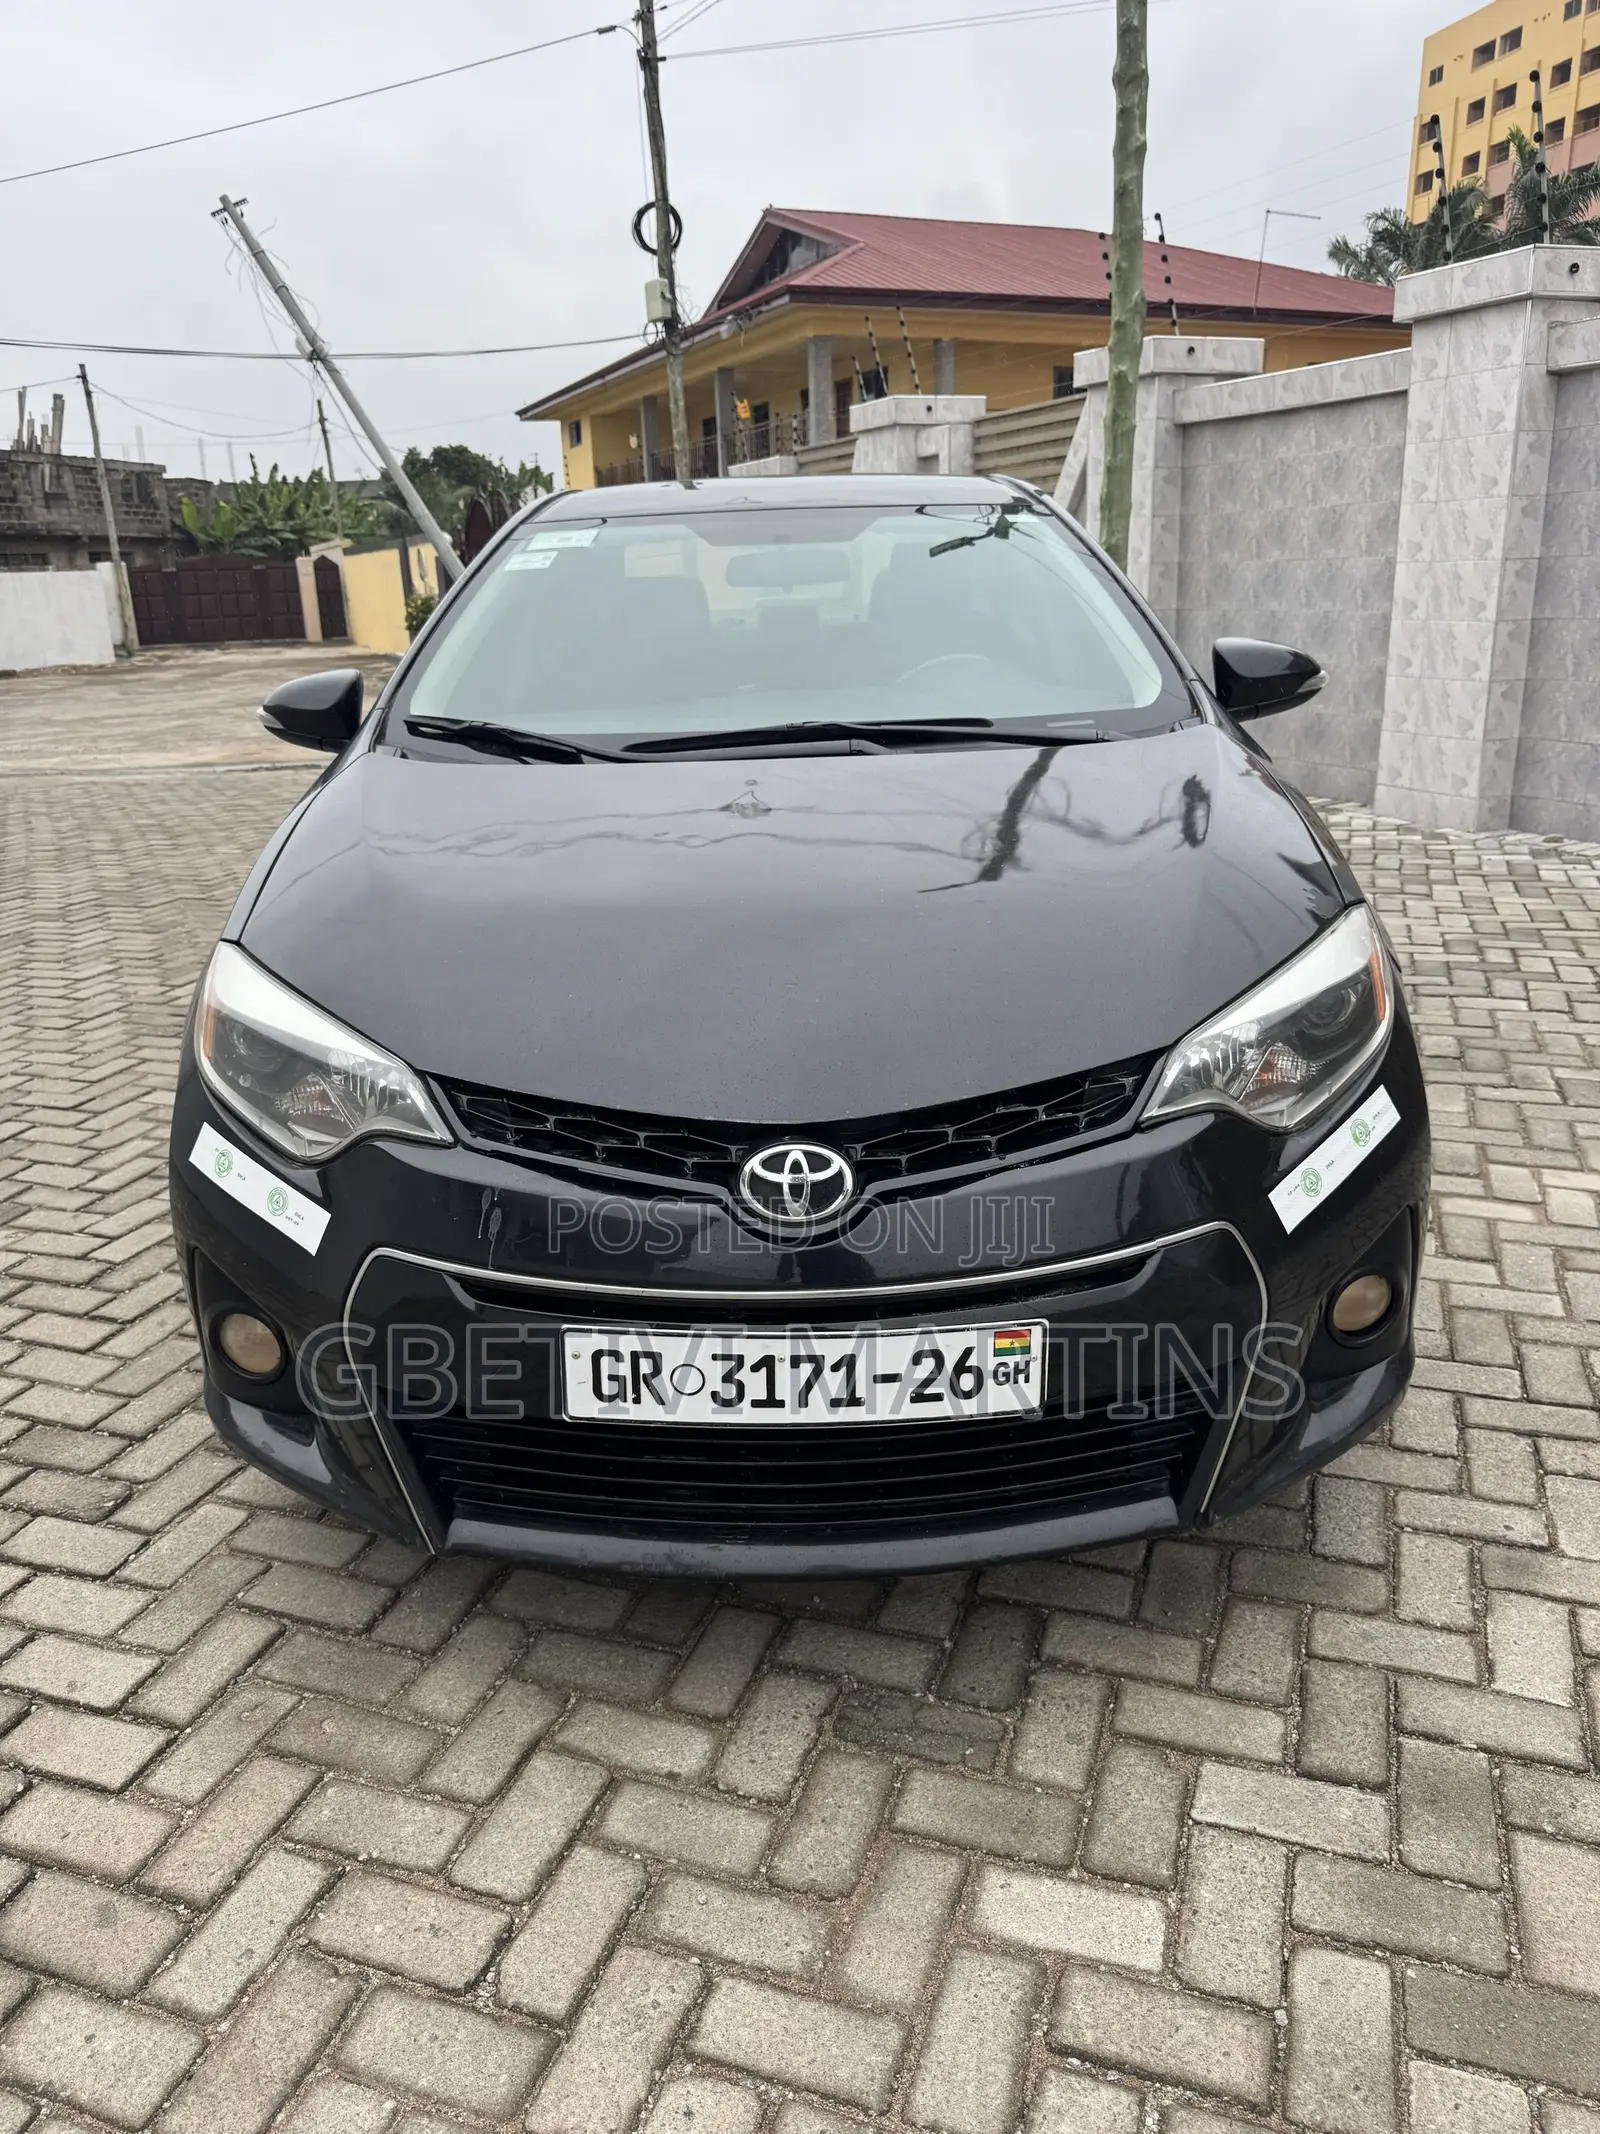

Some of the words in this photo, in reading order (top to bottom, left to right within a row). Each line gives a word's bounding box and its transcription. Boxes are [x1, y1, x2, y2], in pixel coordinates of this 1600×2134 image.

[590, 1347, 667, 1407] GR
[710, 1345, 984, 1410] 3171-26
[991, 1360, 1031, 1386] GH
